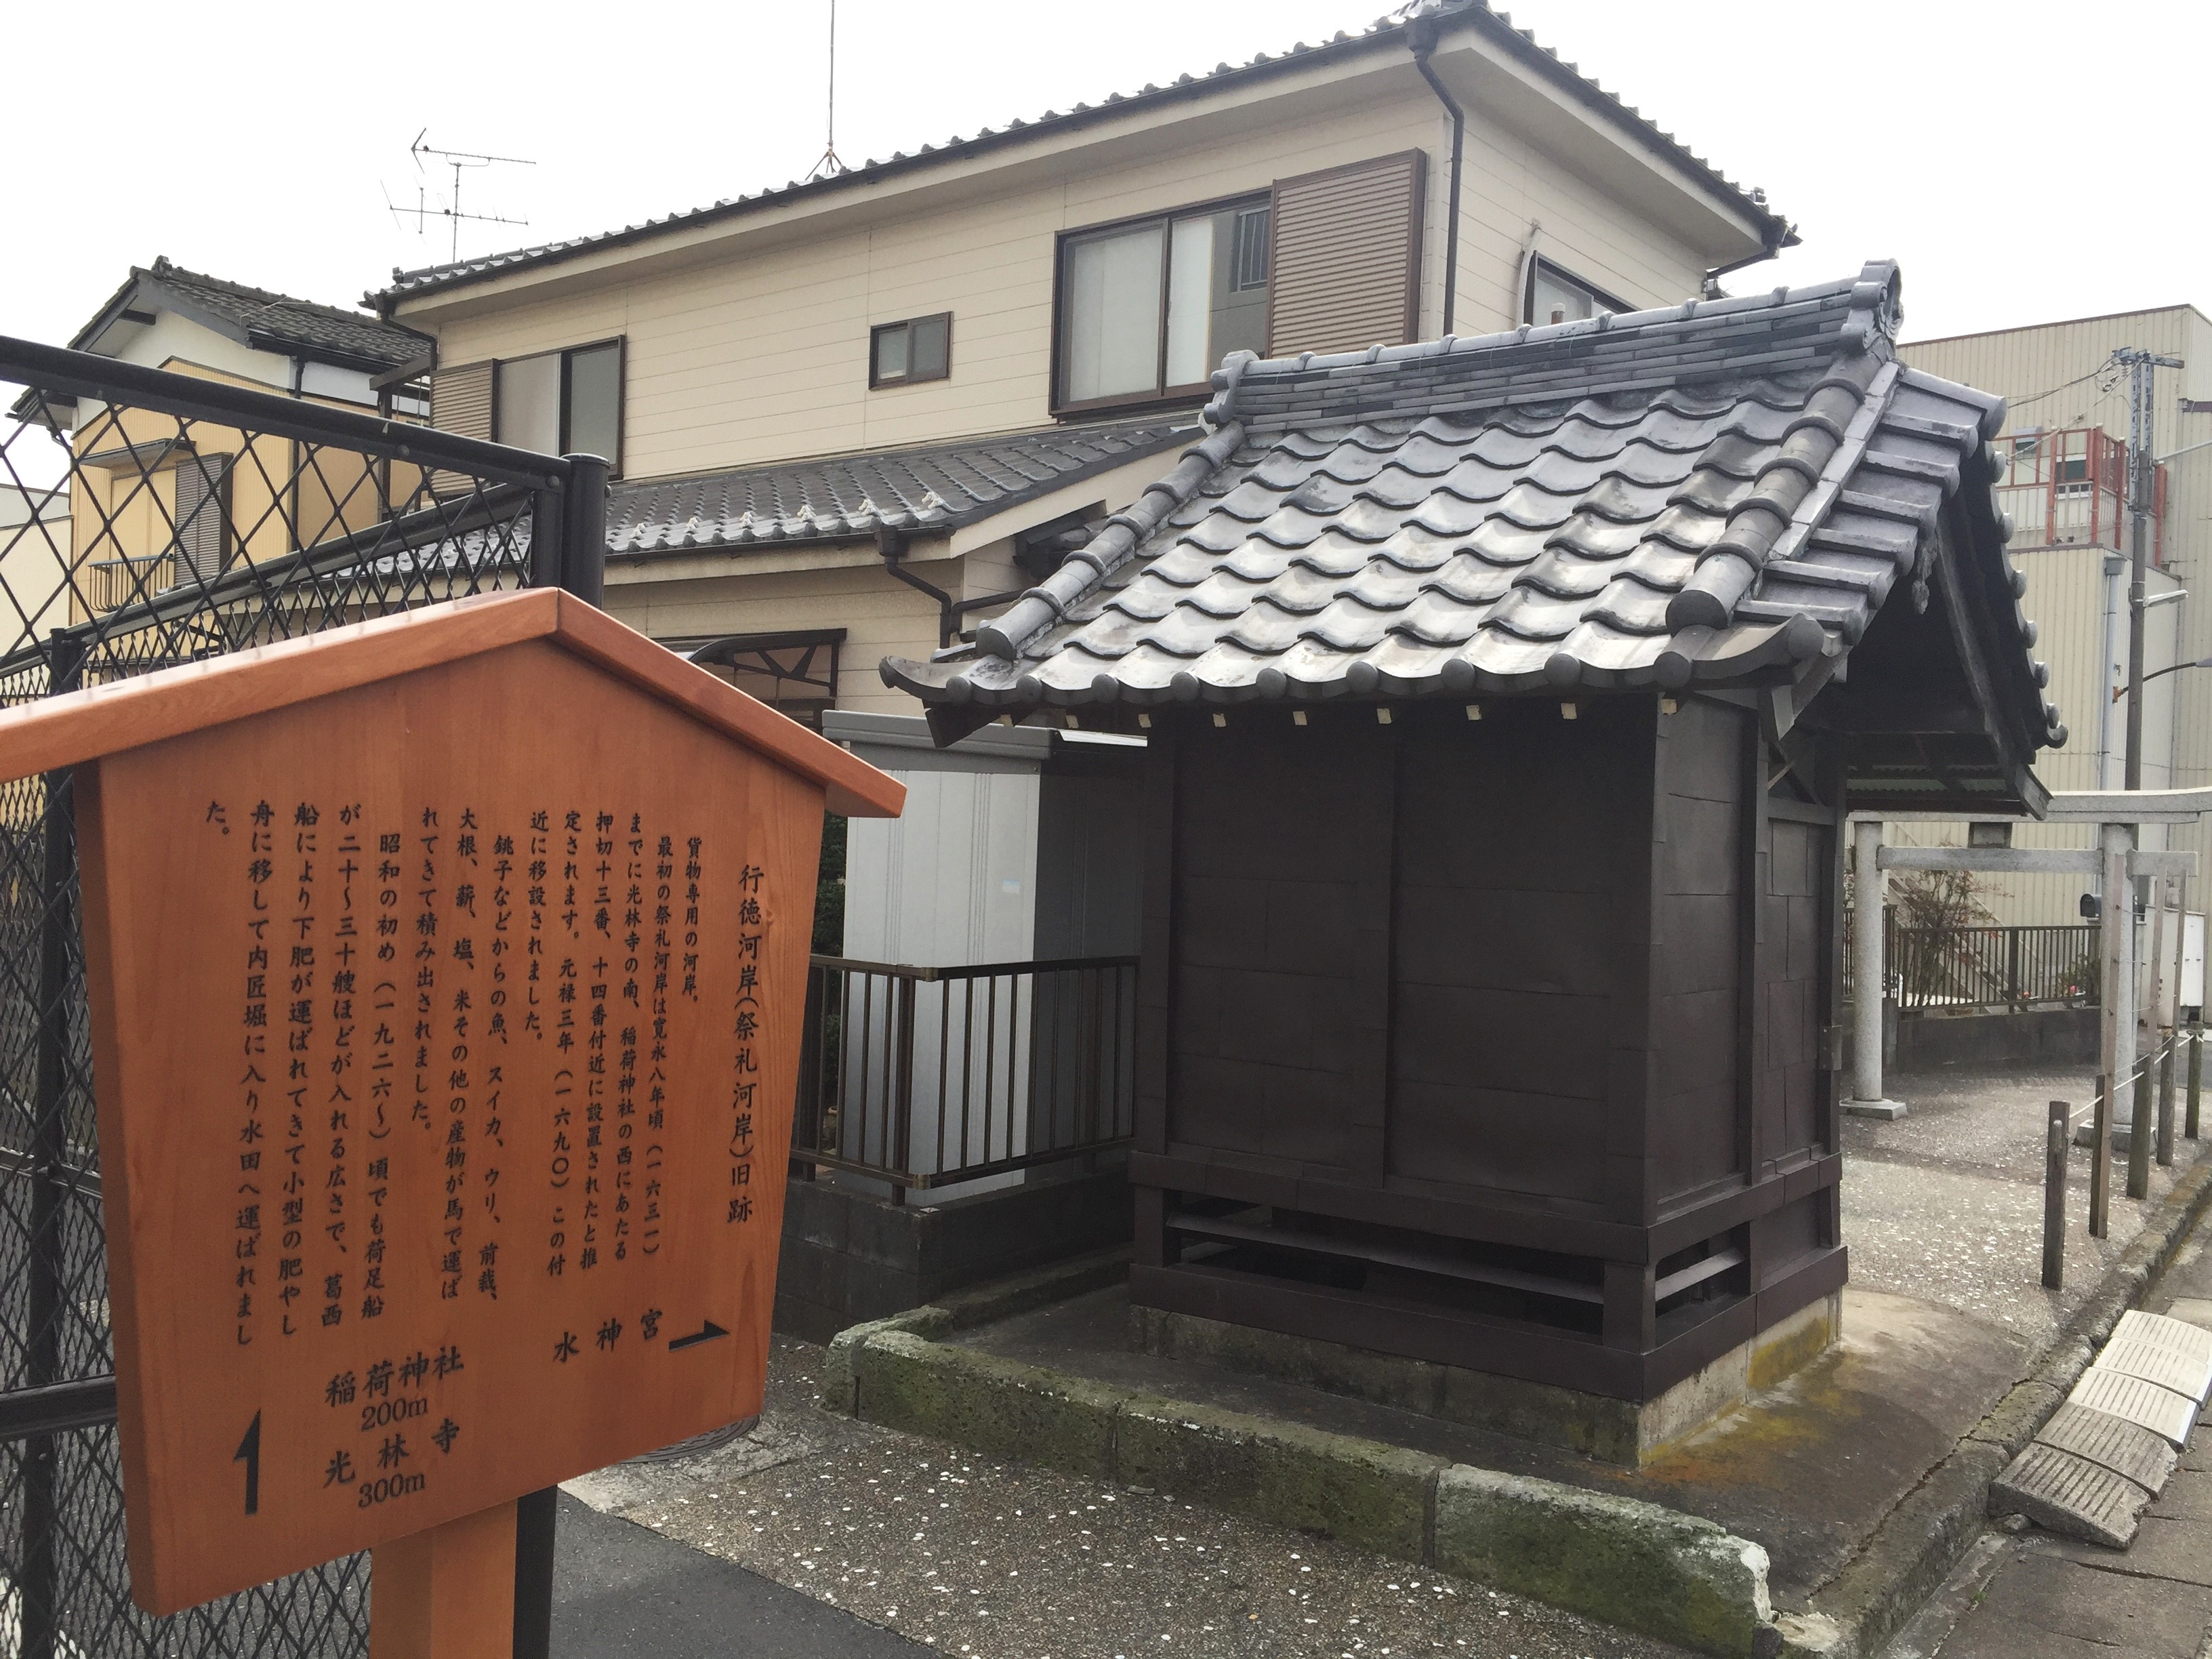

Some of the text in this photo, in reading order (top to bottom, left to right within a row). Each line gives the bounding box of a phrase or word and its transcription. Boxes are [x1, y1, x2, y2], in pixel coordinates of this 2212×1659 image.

[205, 800, 230, 836] た。
[525, 810, 550, 1041] 近に移設されました。
[682, 836, 702, 1002] 貨物専用の河岸。
[412, 806, 439, 1130] れてきて積み出されました。
[324, 1345, 464, 1408] 稲荷神社
[361, 1397, 428, 1432] 200m
[358, 1472, 426, 1508] 300m
